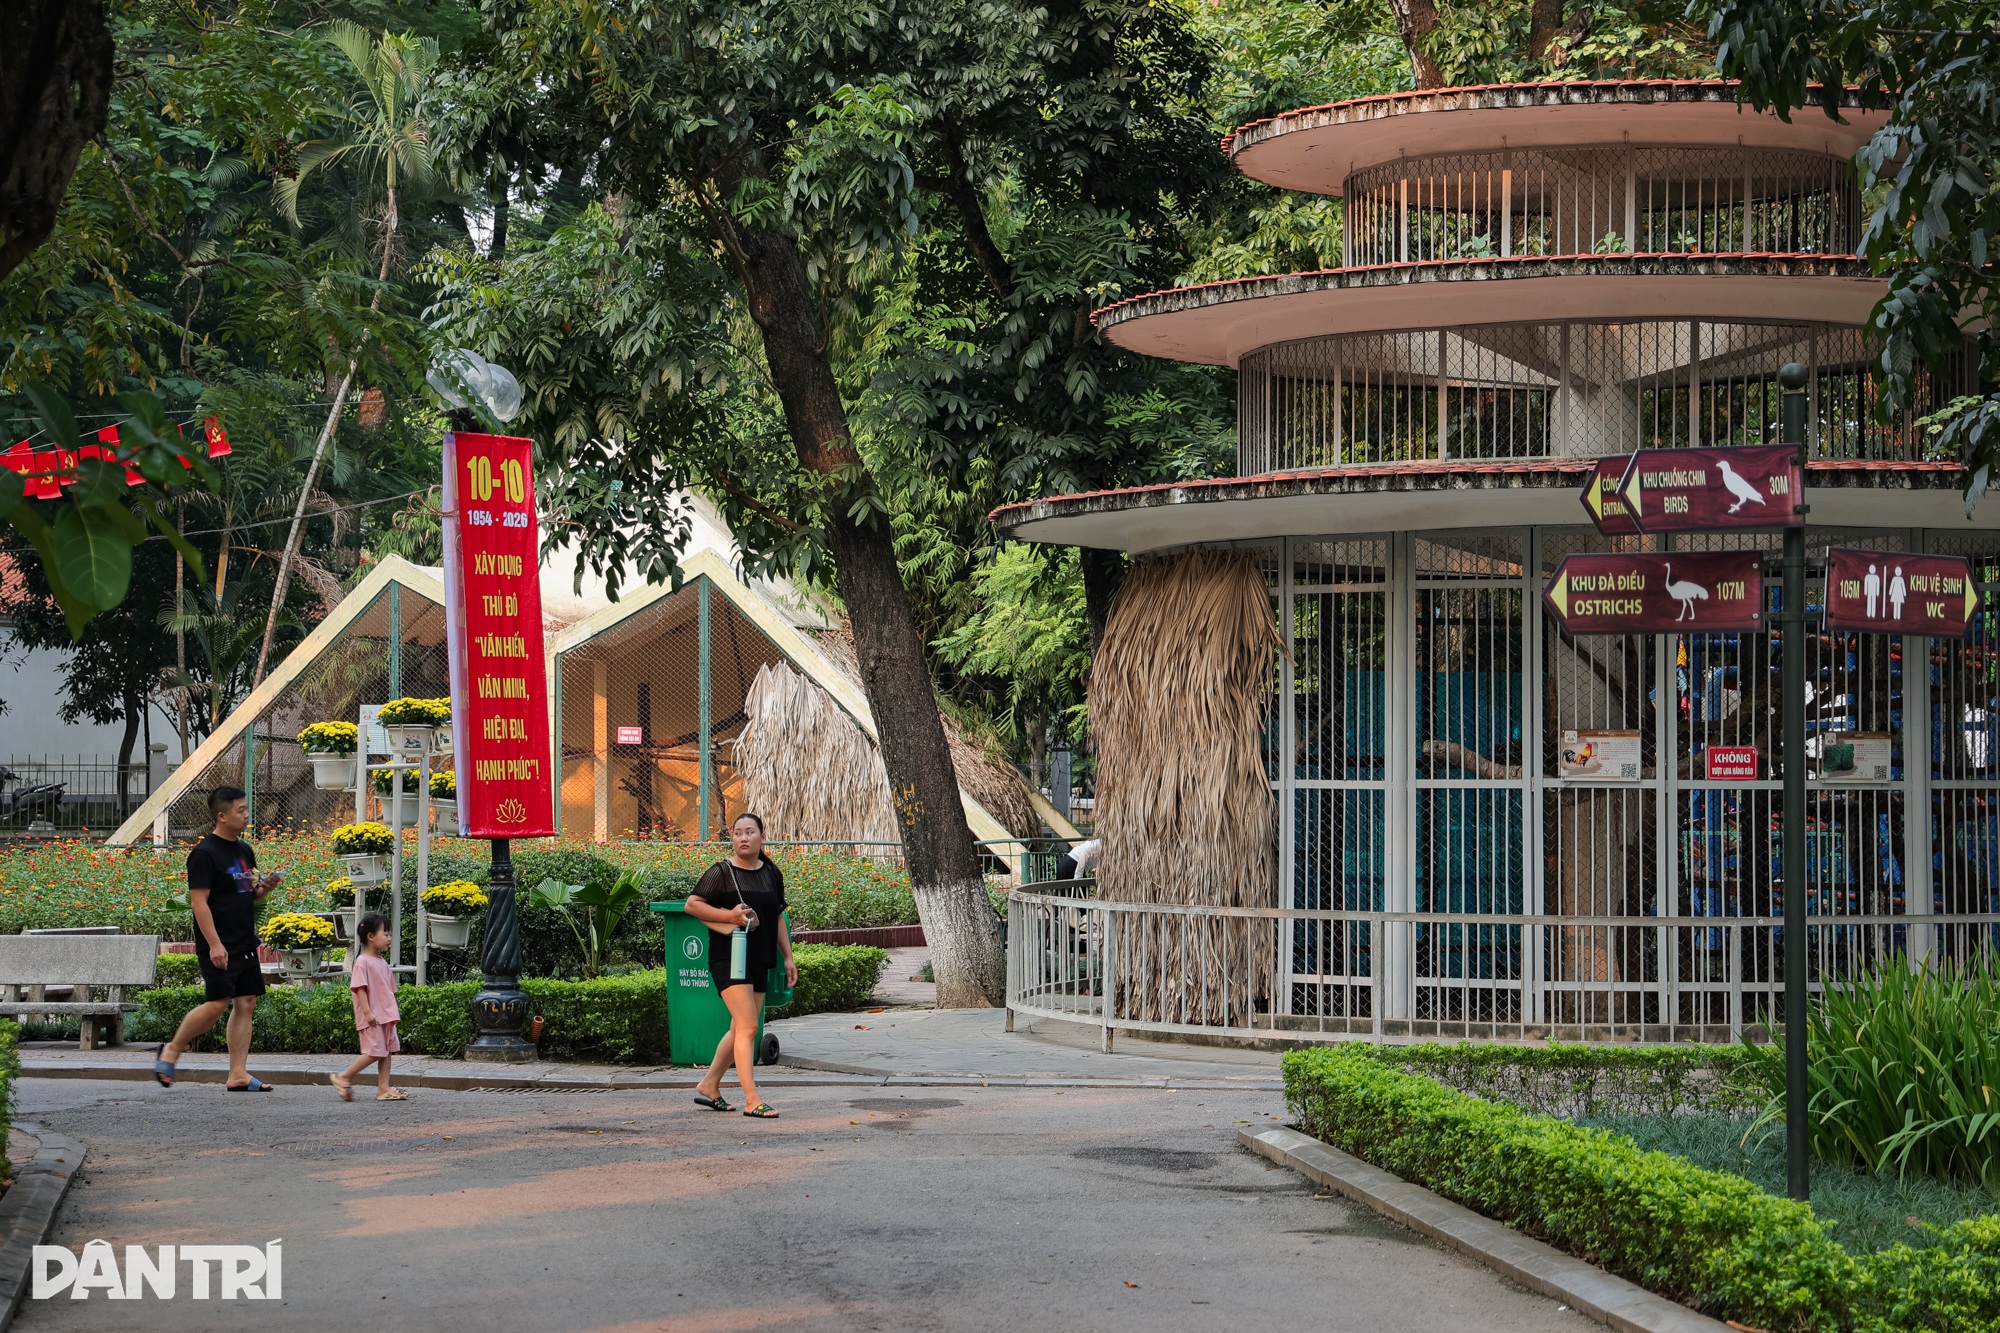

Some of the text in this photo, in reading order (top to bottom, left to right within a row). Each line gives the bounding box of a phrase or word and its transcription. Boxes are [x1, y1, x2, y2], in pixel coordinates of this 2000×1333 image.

[467, 455, 525, 504] 10-10
[1643, 472, 1658, 488] KHU
[1688, 470, 1706, 486] CHIM
[1769, 475, 1789, 495] 30M
[1663, 496, 1689, 513] BIRDS
[467, 510, 492, 526] 1954
[502, 511, 528, 528] 2026
[474, 551, 522, 580] XÂY DỰNG
[1571, 569, 1645, 592] KHU ĐÀ ĐIỂU
[1840, 579, 1860, 599] 105M
[1910, 572, 1962, 596] KHU VỆ SINH
[1716, 581, 1745, 601] 107M
[482, 589, 518, 616] THỦ ĐÔ
[1574, 599, 1643, 616] OSTRICHS
[1926, 601, 1945, 618] WC
[503, 631, 529, 660] HIẾN,
[477, 674, 530, 701] VĂN MINH,
[483, 714, 528, 743] HIỆN ĐẠI,
[1714, 750, 1751, 763] KHÔNG
[475, 759, 506, 785] HẠNH
[679, 977, 709, 987] VÀO THÙNG
[698, 968, 708, 977] RÁC
